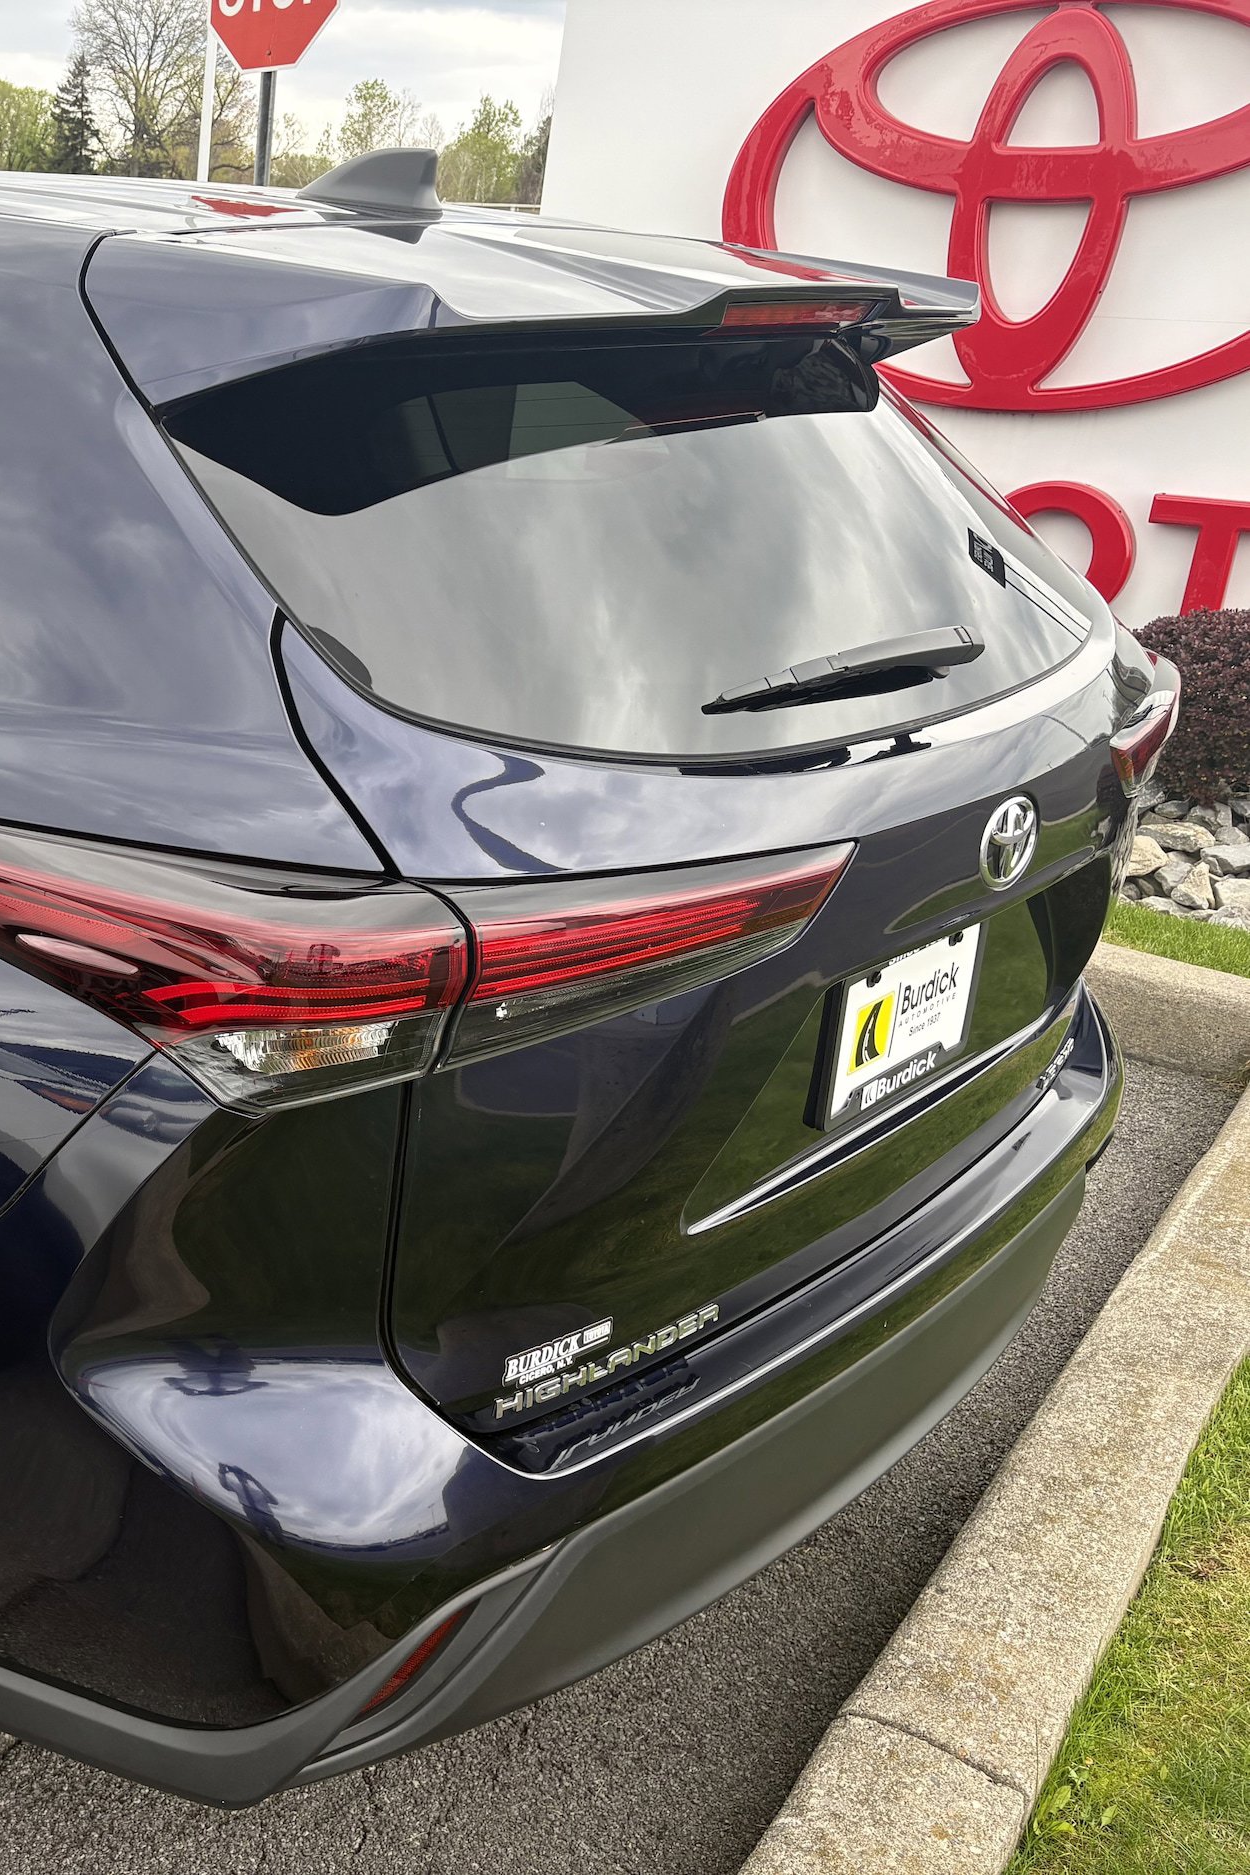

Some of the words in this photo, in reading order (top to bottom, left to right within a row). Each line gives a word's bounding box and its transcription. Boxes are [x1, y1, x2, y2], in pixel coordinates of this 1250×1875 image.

[898, 992, 956, 1028] AUTOMOTIVE
[901, 961, 960, 1015] Burdick
[908, 1022, 925, 1037] Since
[927, 1012, 941, 1027] 1937
[876, 1050, 937, 1100] Burdick
[494, 1303, 720, 1420] HIGHLANDER
[506, 1333, 581, 1378] BURDICK
[518, 1364, 555, 1385] CICERO,
[557, 1356, 573, 1370] N.Y.
